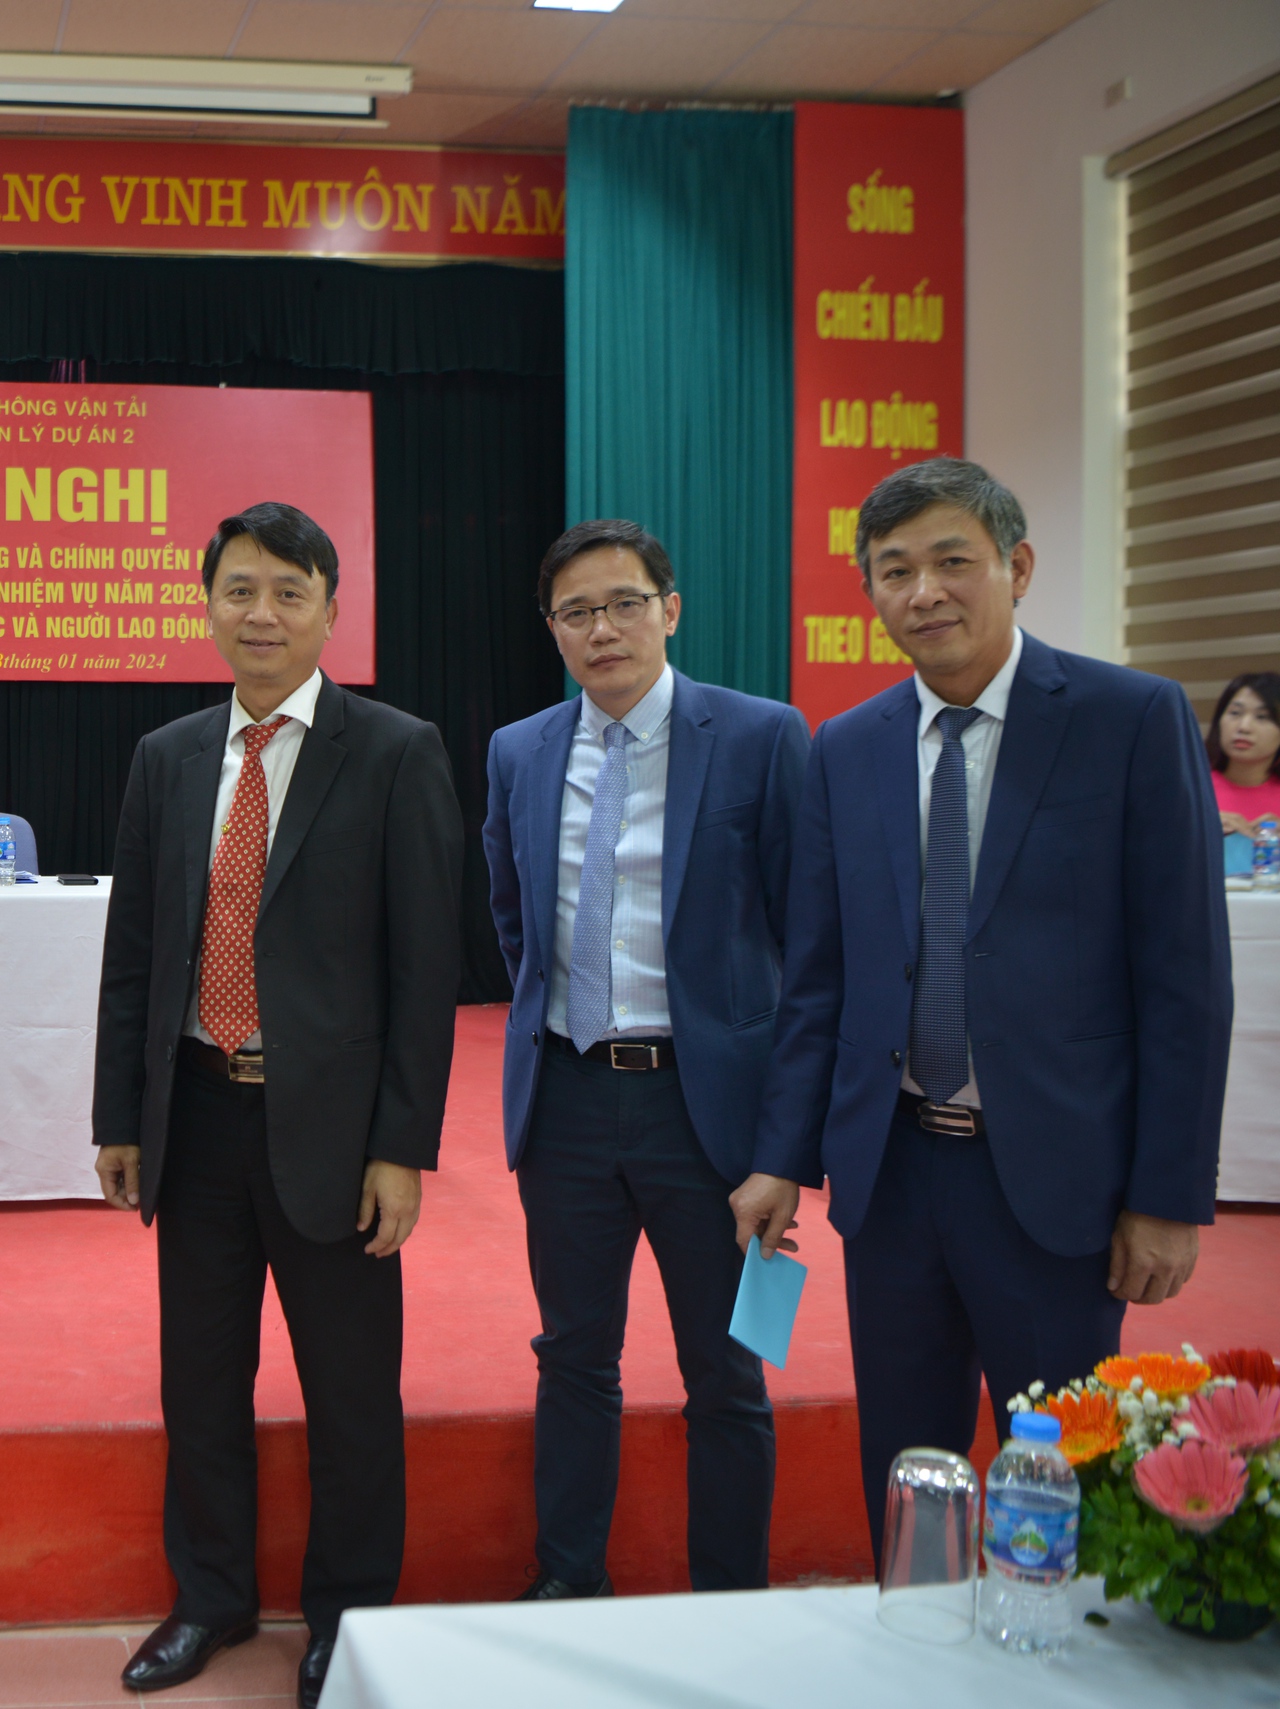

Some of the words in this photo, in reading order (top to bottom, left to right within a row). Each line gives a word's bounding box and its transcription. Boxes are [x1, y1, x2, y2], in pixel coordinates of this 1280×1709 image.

[102, 176, 247, 227] VINH
[263, 167, 434, 231] MUÔN
[451, 176, 564, 235] NĂM
[848, 170, 914, 233] SỐNG
[817, 278, 890, 340] CHIẾN
[894, 280, 943, 342] ĐẤU
[65, 397, 107, 419] VẬN
[114, 396, 146, 416] TẢI
[821, 400, 867, 447] LAO
[872, 392, 938, 458] ĐỘNG
[19, 423, 44, 442] LÝ
[52, 426, 82, 445] DỰ
[88, 425, 116, 443] ÁN
[124, 428, 134, 444] 2
[6, 467, 167, 535] NGHỊ
[17, 543, 43, 568] VÀ
[50, 544, 114, 568] CHÍNH
[71, 582, 97, 608] VỤ
[105, 579, 153, 603] NĂM
[160, 583, 208, 604] 2024
[13, 612, 39, 638] VÀ
[46, 612, 110, 638] NGƯỜI
[118, 617, 155, 638] LAO
[804, 616, 864, 663] THEO
[58, 654, 77, 668] 01
[84, 655, 120, 668] năm
[126, 654, 166, 669] 2024
